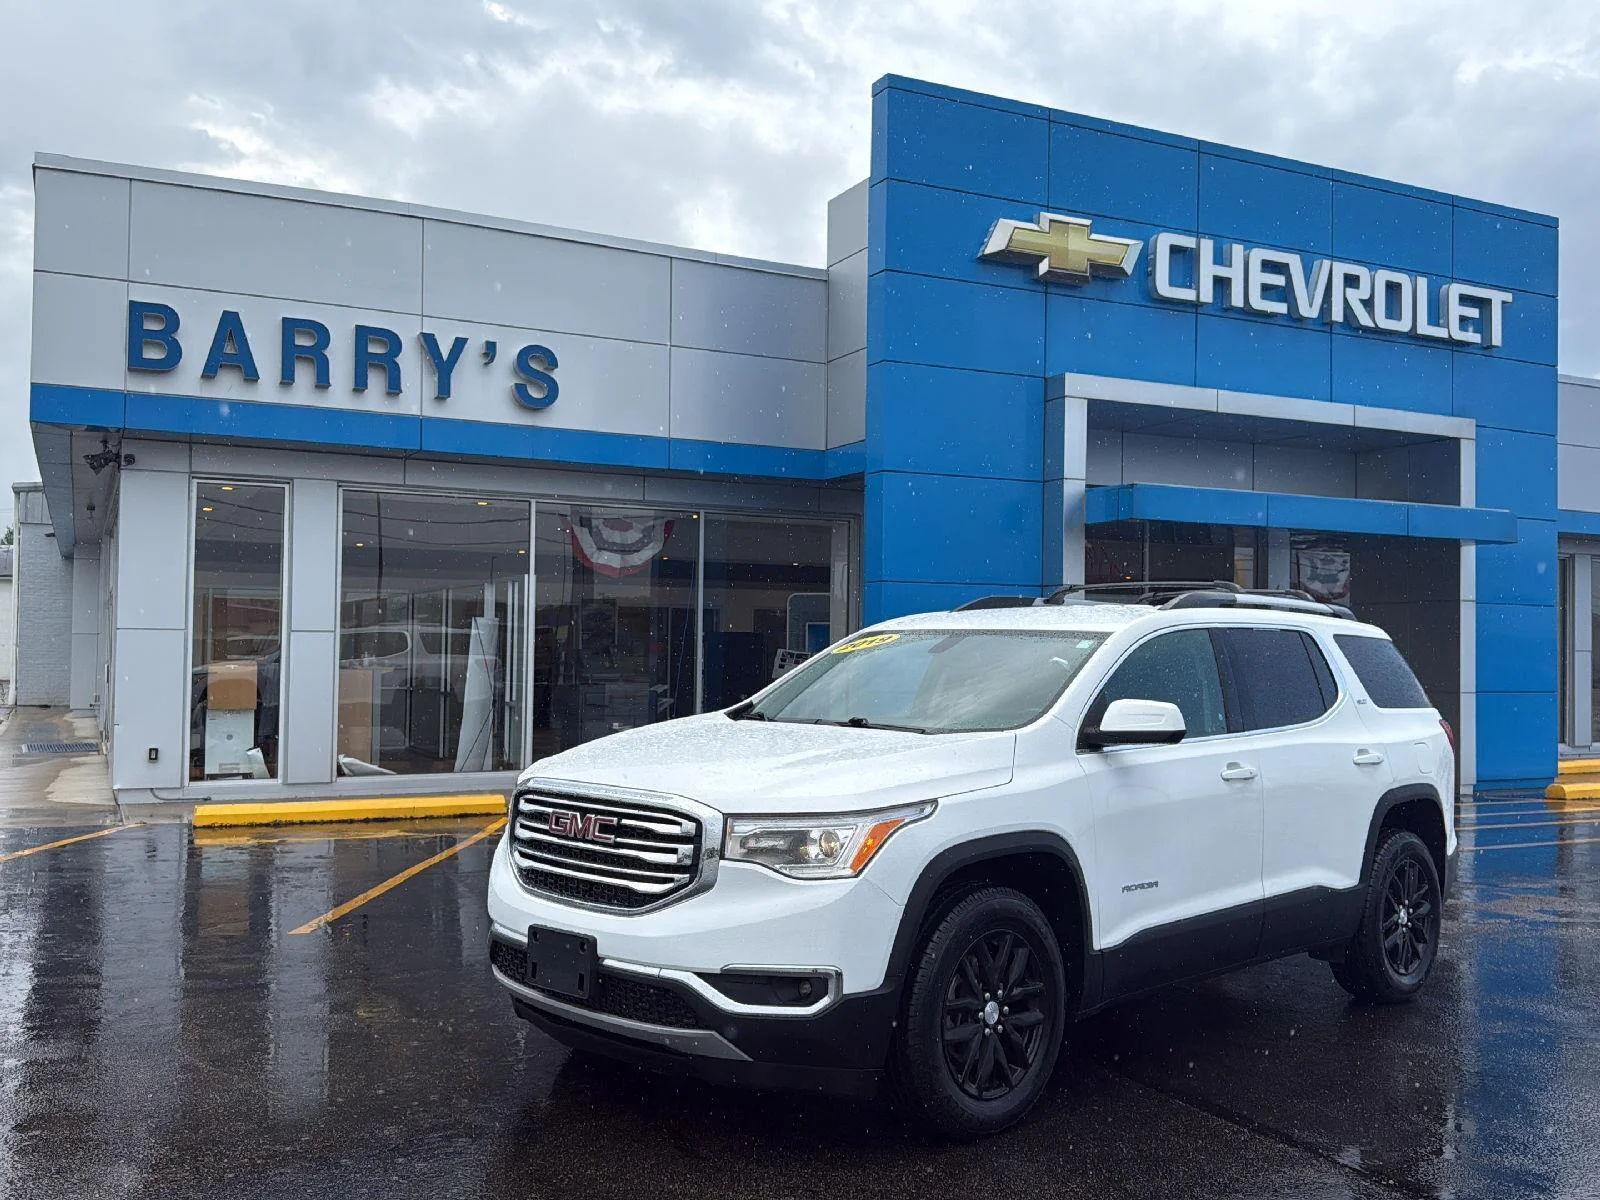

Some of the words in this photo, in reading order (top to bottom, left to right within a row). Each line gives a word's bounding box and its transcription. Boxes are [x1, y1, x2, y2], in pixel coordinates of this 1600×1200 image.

[1150, 232, 1513, 348] CHEVROLET
[127, 299, 560, 411] BARRY'S
[549, 810, 618, 844] GMC
